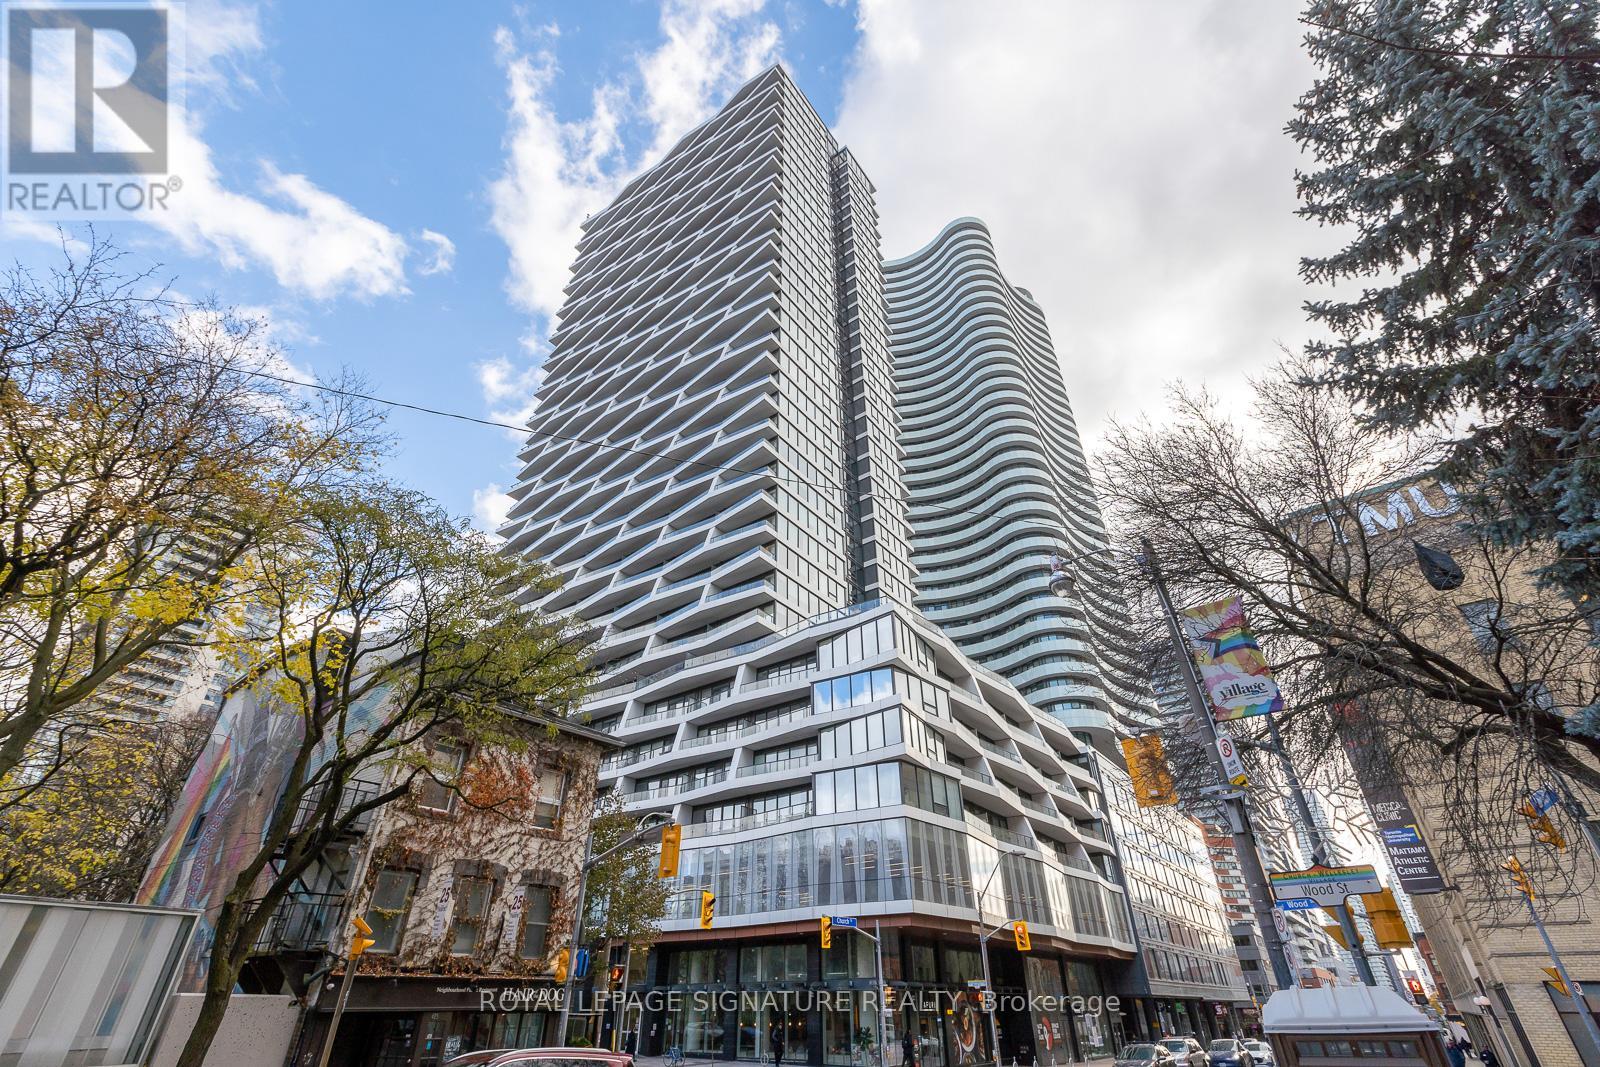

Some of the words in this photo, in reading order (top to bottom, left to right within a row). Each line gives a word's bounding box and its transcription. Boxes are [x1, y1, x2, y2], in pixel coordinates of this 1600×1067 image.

[1376, 811, 1401, 822] CLINIC
[1389, 846, 1426, 856] MATTAMY
[1394, 856, 1430, 866] ATHLETIC
[1397, 866, 1429, 875] CENTRE
[440, 887, 451, 903] 25
[1301, 884, 1334, 897] Wood
[1337, 883, 1353, 894] St.
[512, 895, 523, 910] 25
[1286, 901, 1309, 909] Wood
[836, 917, 850, 925] Church
[503, 987, 535, 1001] HAIR
[538, 987, 565, 1001] DOG
